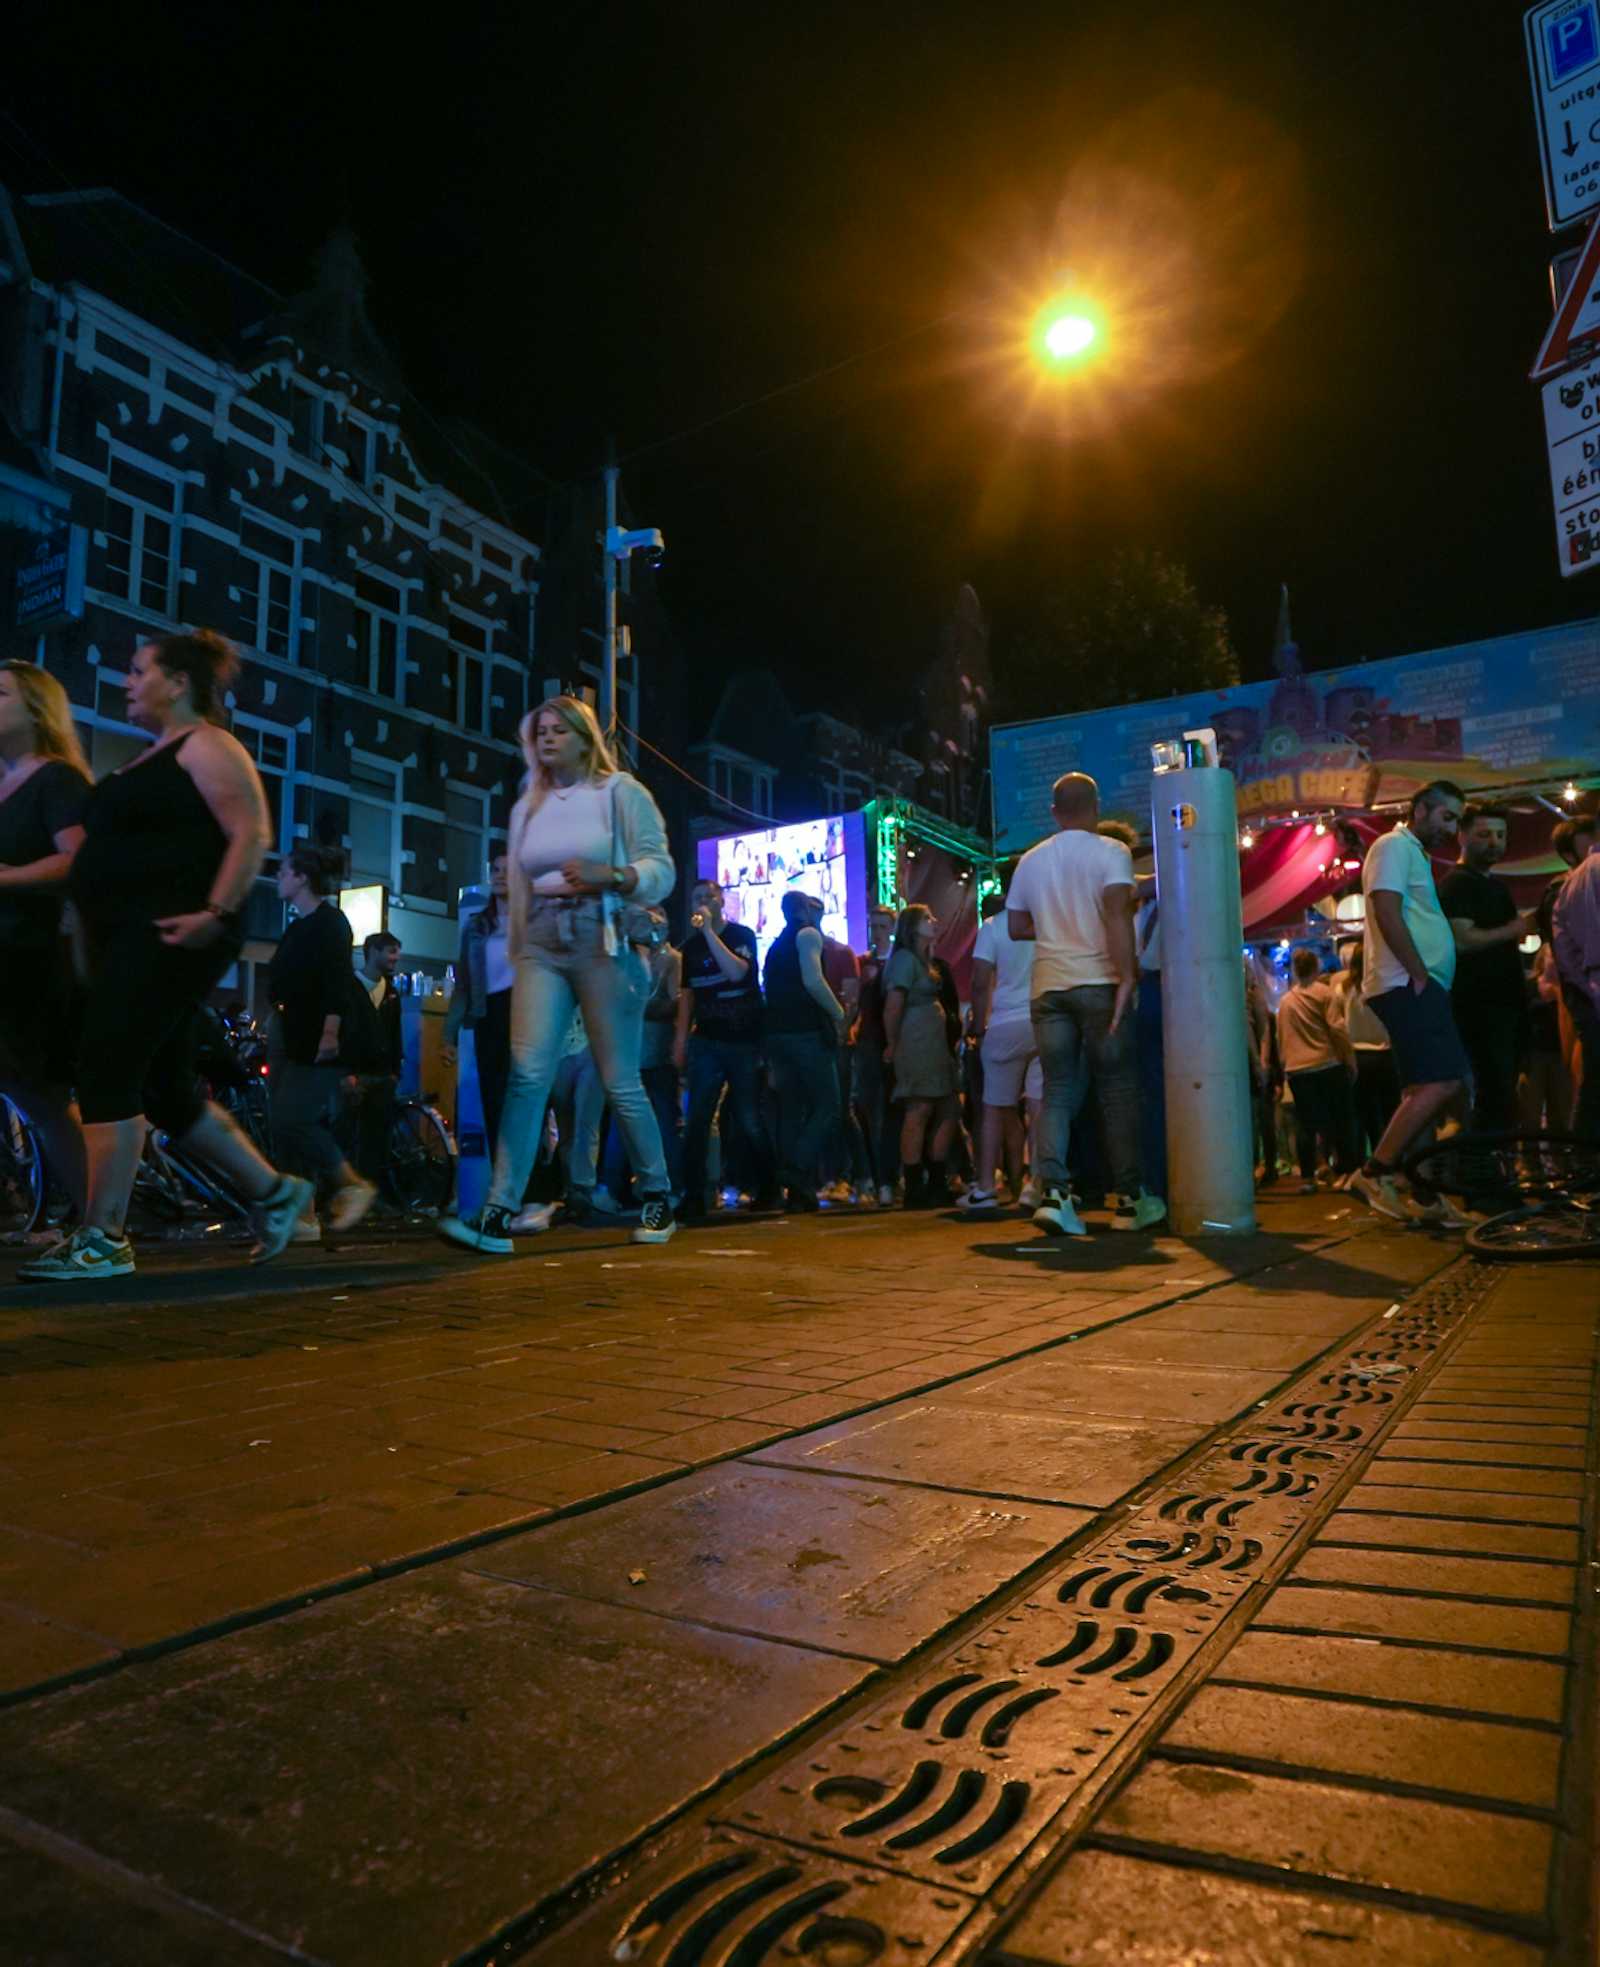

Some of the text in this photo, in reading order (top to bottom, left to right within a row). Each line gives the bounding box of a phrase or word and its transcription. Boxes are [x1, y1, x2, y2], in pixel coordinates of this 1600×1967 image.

[1559, 16, 1582, 52] P
[1575, 179, 1597, 198] 06
[1238, 774, 1294, 810] EGA
